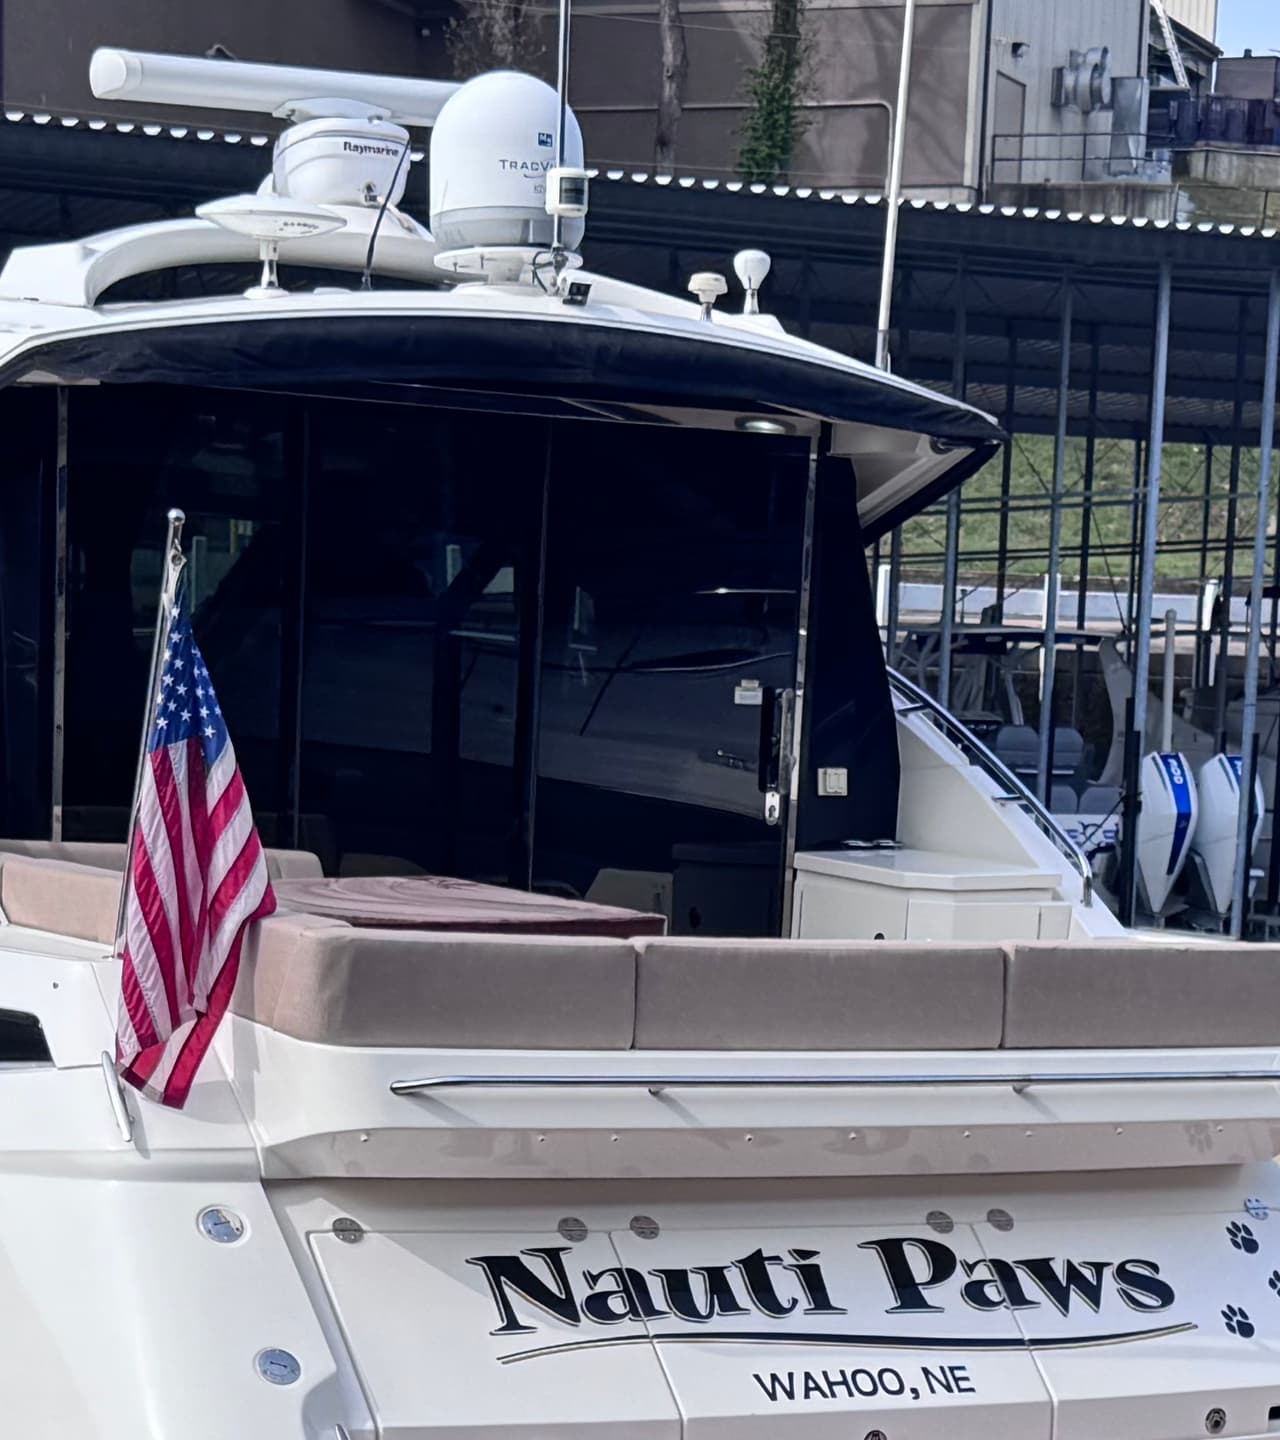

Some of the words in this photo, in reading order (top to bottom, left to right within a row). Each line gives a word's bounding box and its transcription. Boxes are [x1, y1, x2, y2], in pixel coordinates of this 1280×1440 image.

[343, 141, 399, 157] Raymarine
[465, 1246, 848, 1336] Nauti
[857, 1237, 1176, 1319] Paws
